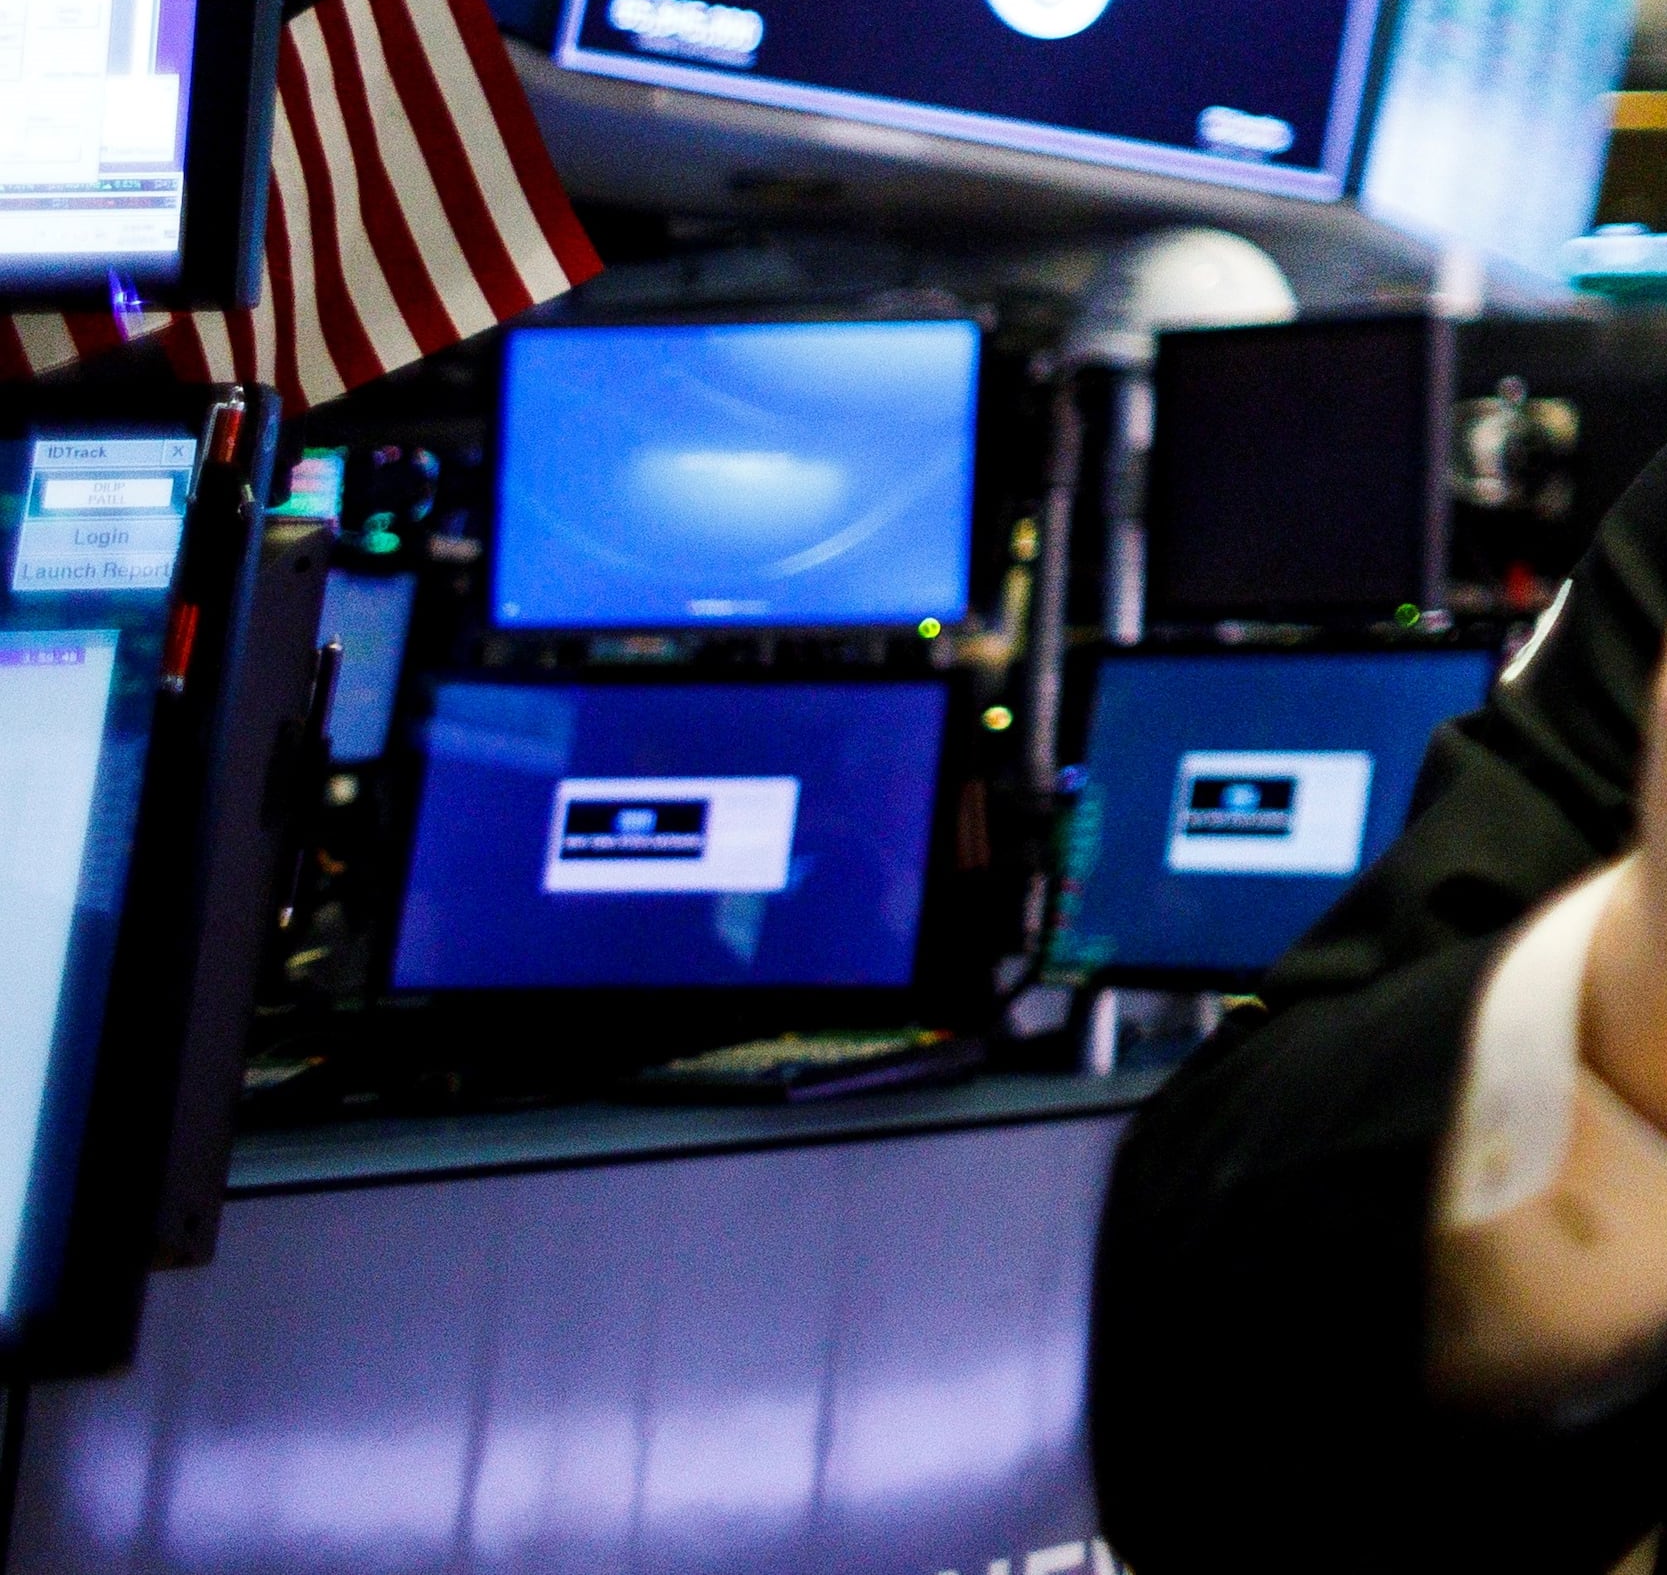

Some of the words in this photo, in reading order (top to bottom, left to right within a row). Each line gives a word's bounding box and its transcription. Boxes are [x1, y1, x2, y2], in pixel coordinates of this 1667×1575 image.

[47, 446, 108, 459] IDTrack
[74, 528, 130, 548] Login
[21, 563, 97, 581] Launch
